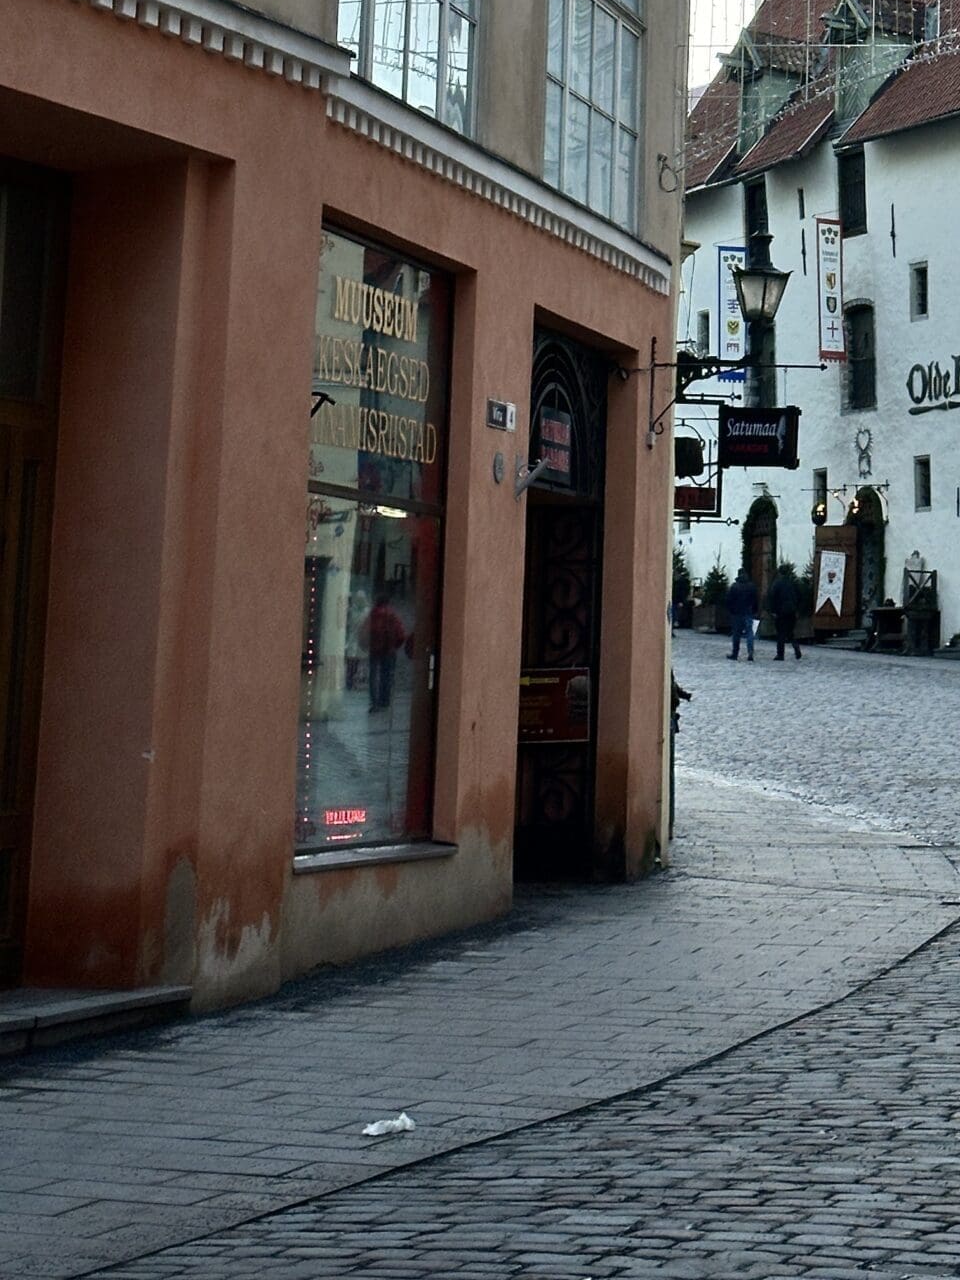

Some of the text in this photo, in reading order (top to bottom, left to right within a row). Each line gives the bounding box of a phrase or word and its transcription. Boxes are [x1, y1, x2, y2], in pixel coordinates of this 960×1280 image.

[334, 275, 419, 343] MUUSEUM
[318, 334, 430, 403] KESKAEGSED
[906, 360, 950, 404] Olde
[726, 418, 777, 437] Satumaa
